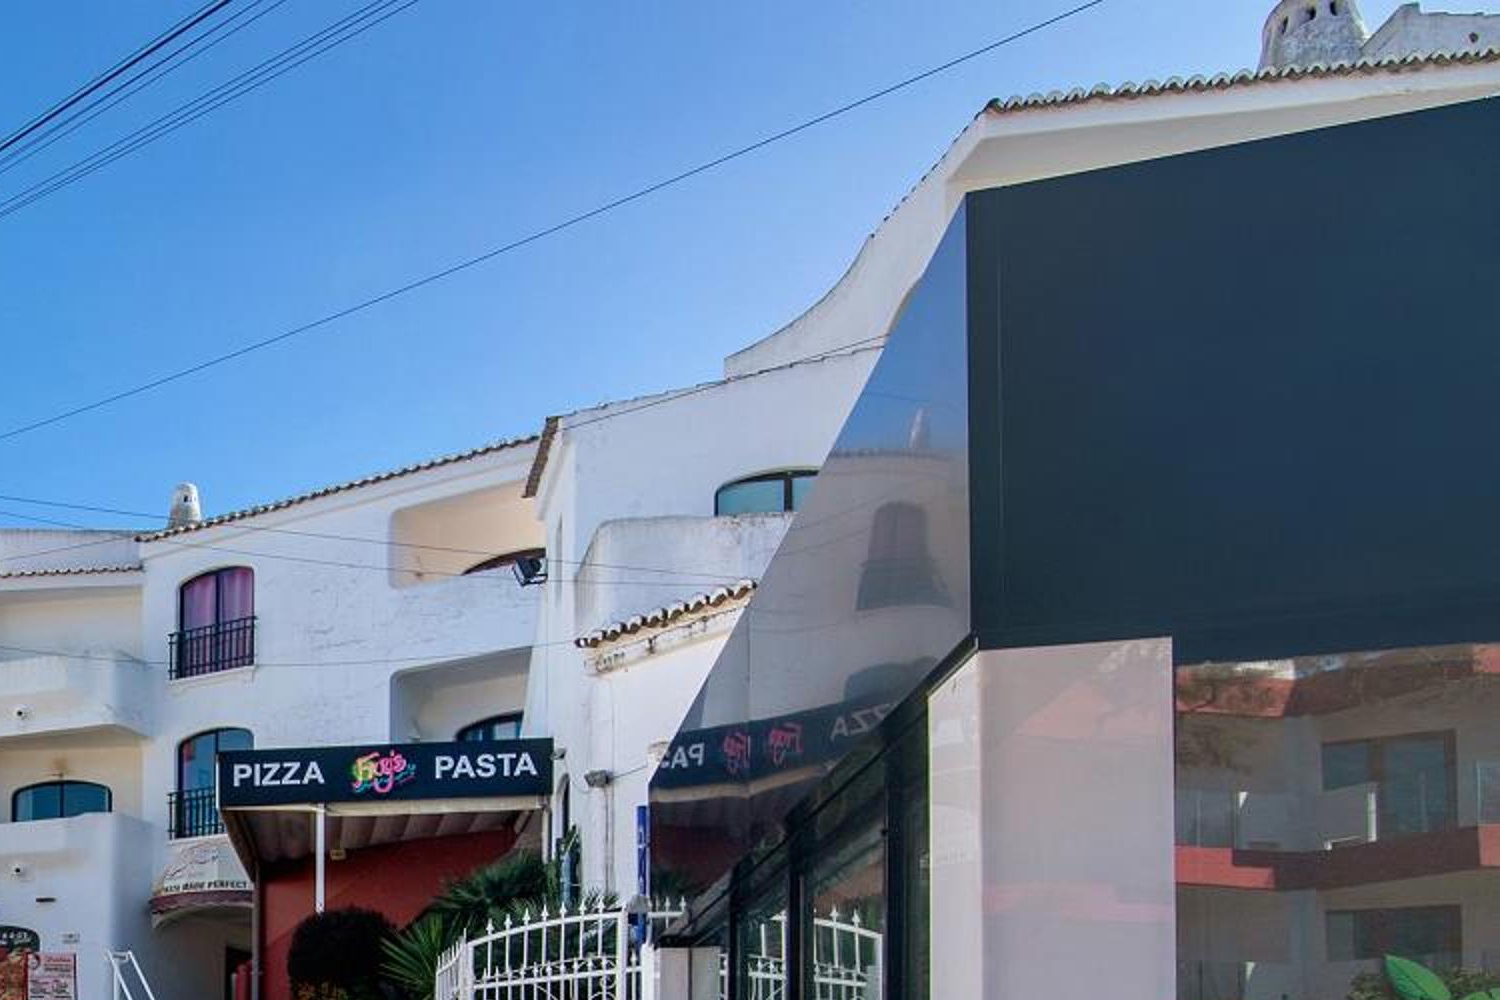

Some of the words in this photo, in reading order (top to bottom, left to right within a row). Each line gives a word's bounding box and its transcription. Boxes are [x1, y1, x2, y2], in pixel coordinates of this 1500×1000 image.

[233, 761, 325, 787] PIZZA
[435, 752, 538, 779] PASTA
[207, 879, 247, 889] PERFECT
